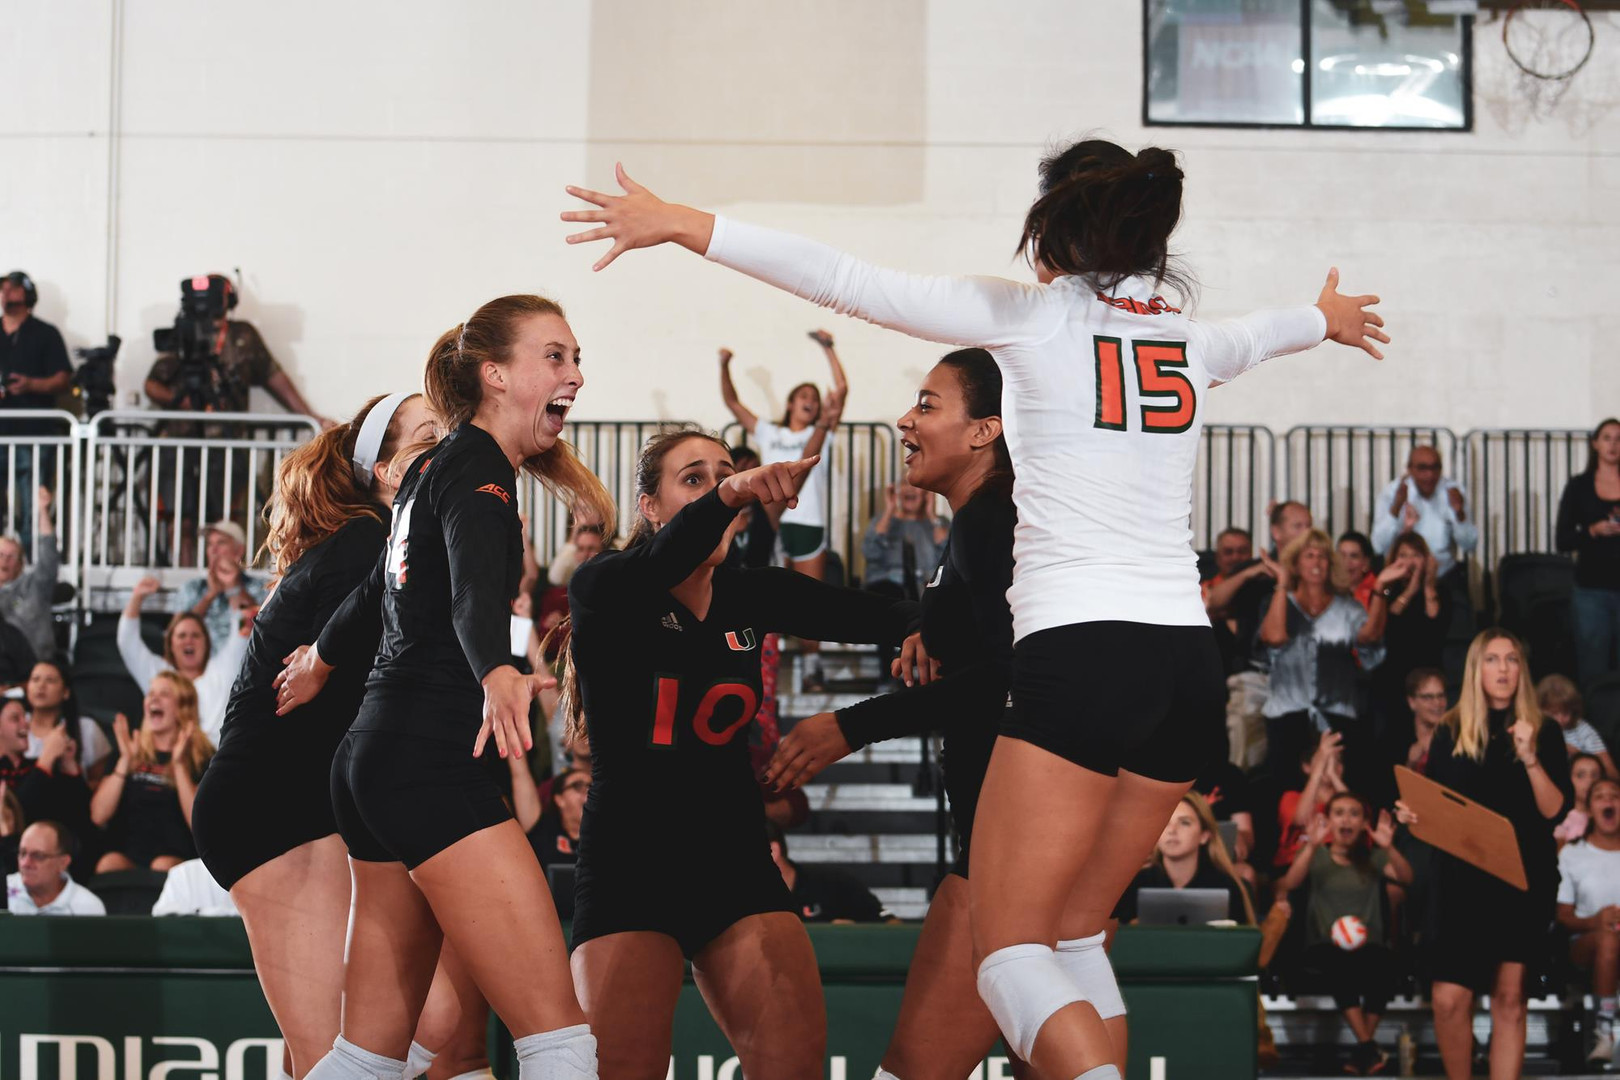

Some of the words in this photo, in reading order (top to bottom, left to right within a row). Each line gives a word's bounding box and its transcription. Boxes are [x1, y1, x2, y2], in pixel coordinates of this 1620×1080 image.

[1093, 335, 1197, 434] 15
[474, 483, 512, 505] ACC
[725, 627, 756, 651] U
[651, 675, 758, 747] 10
